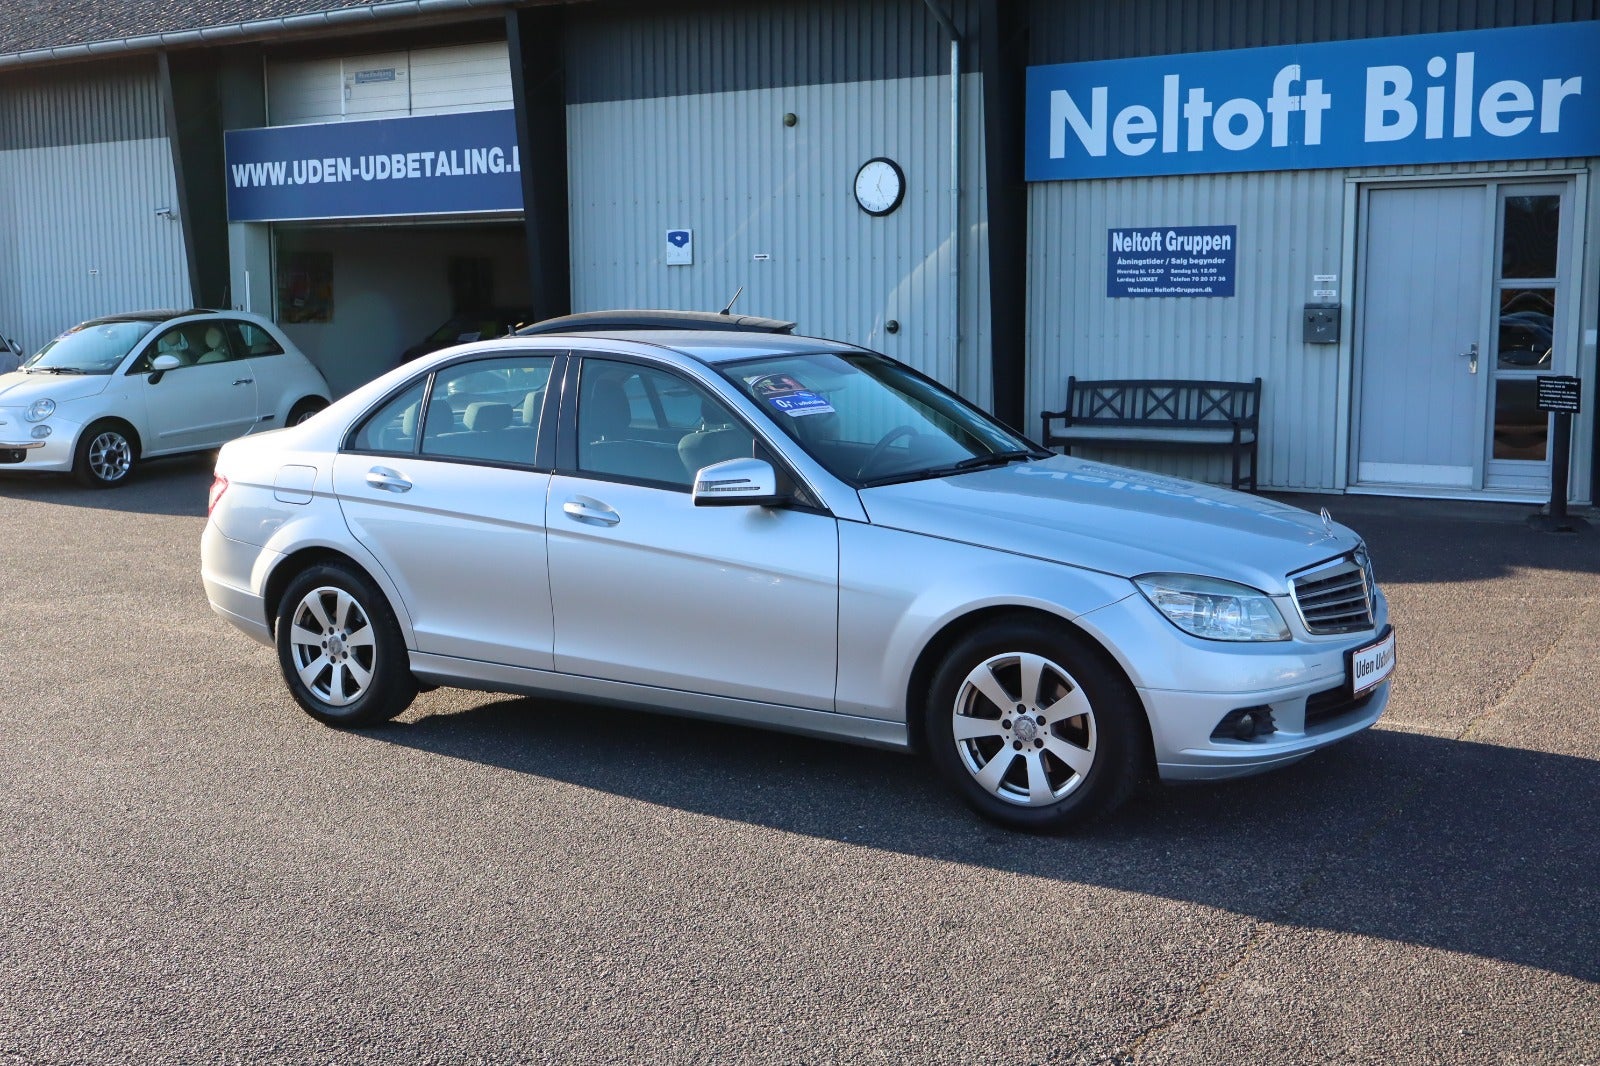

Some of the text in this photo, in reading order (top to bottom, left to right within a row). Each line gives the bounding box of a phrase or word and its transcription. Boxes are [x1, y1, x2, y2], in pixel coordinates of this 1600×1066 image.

[1049, 51, 1583, 159] Neltoft Biler
[1112, 230, 1231, 255] Neltoft Gruppen
[1117, 256, 1226, 266] Åbningstider / Salg begynder
[1154, 286, 1213, 294] Neltoft-Gruppen.dk
[1356, 658, 1374, 679] Uden
